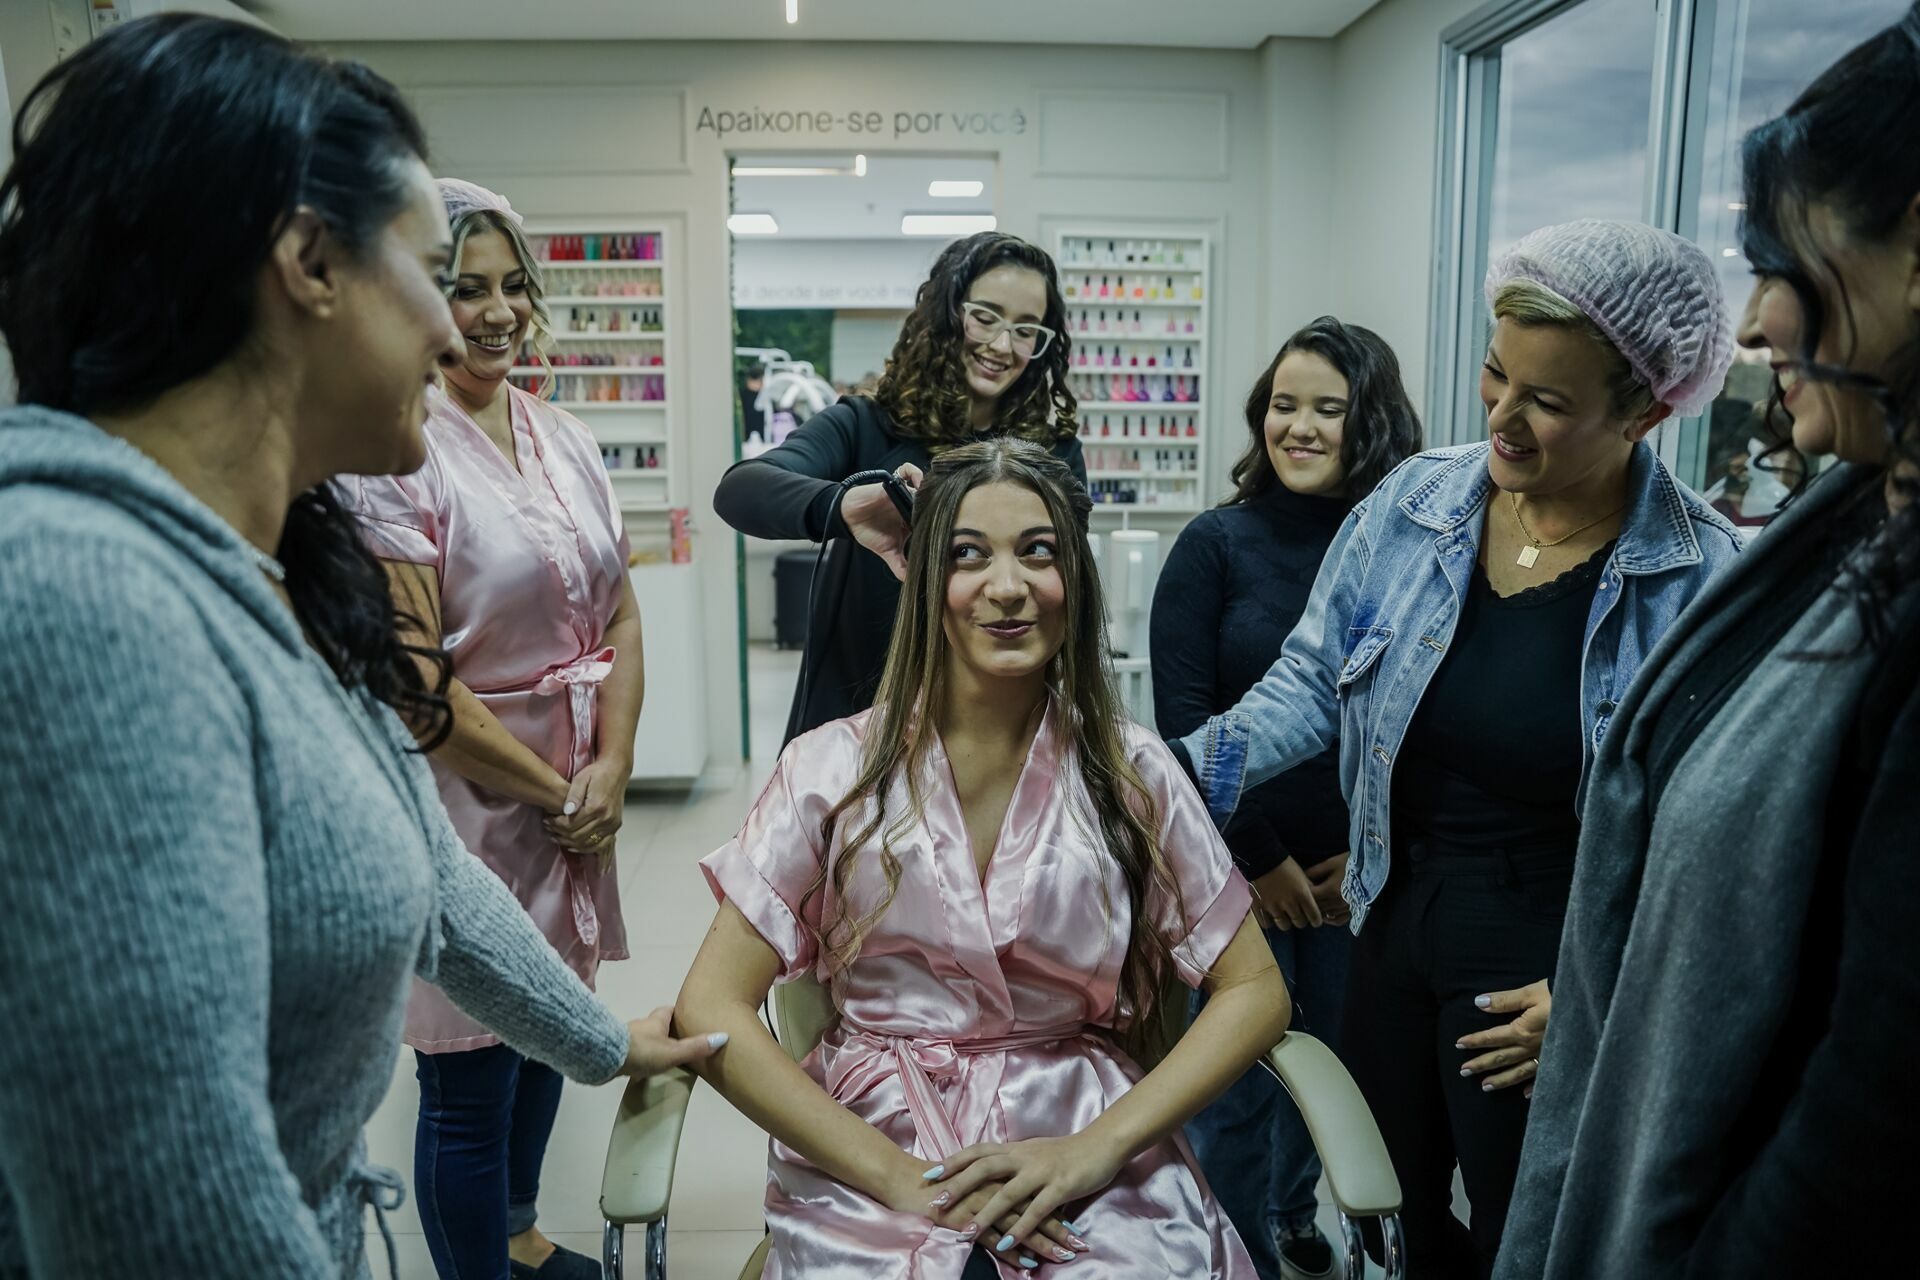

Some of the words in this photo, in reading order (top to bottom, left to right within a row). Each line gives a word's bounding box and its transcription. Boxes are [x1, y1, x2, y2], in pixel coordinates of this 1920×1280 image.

[695, 105, 883, 139] Apaixone-se
[893, 110, 944, 139] por
[952, 107, 1028, 135] você
